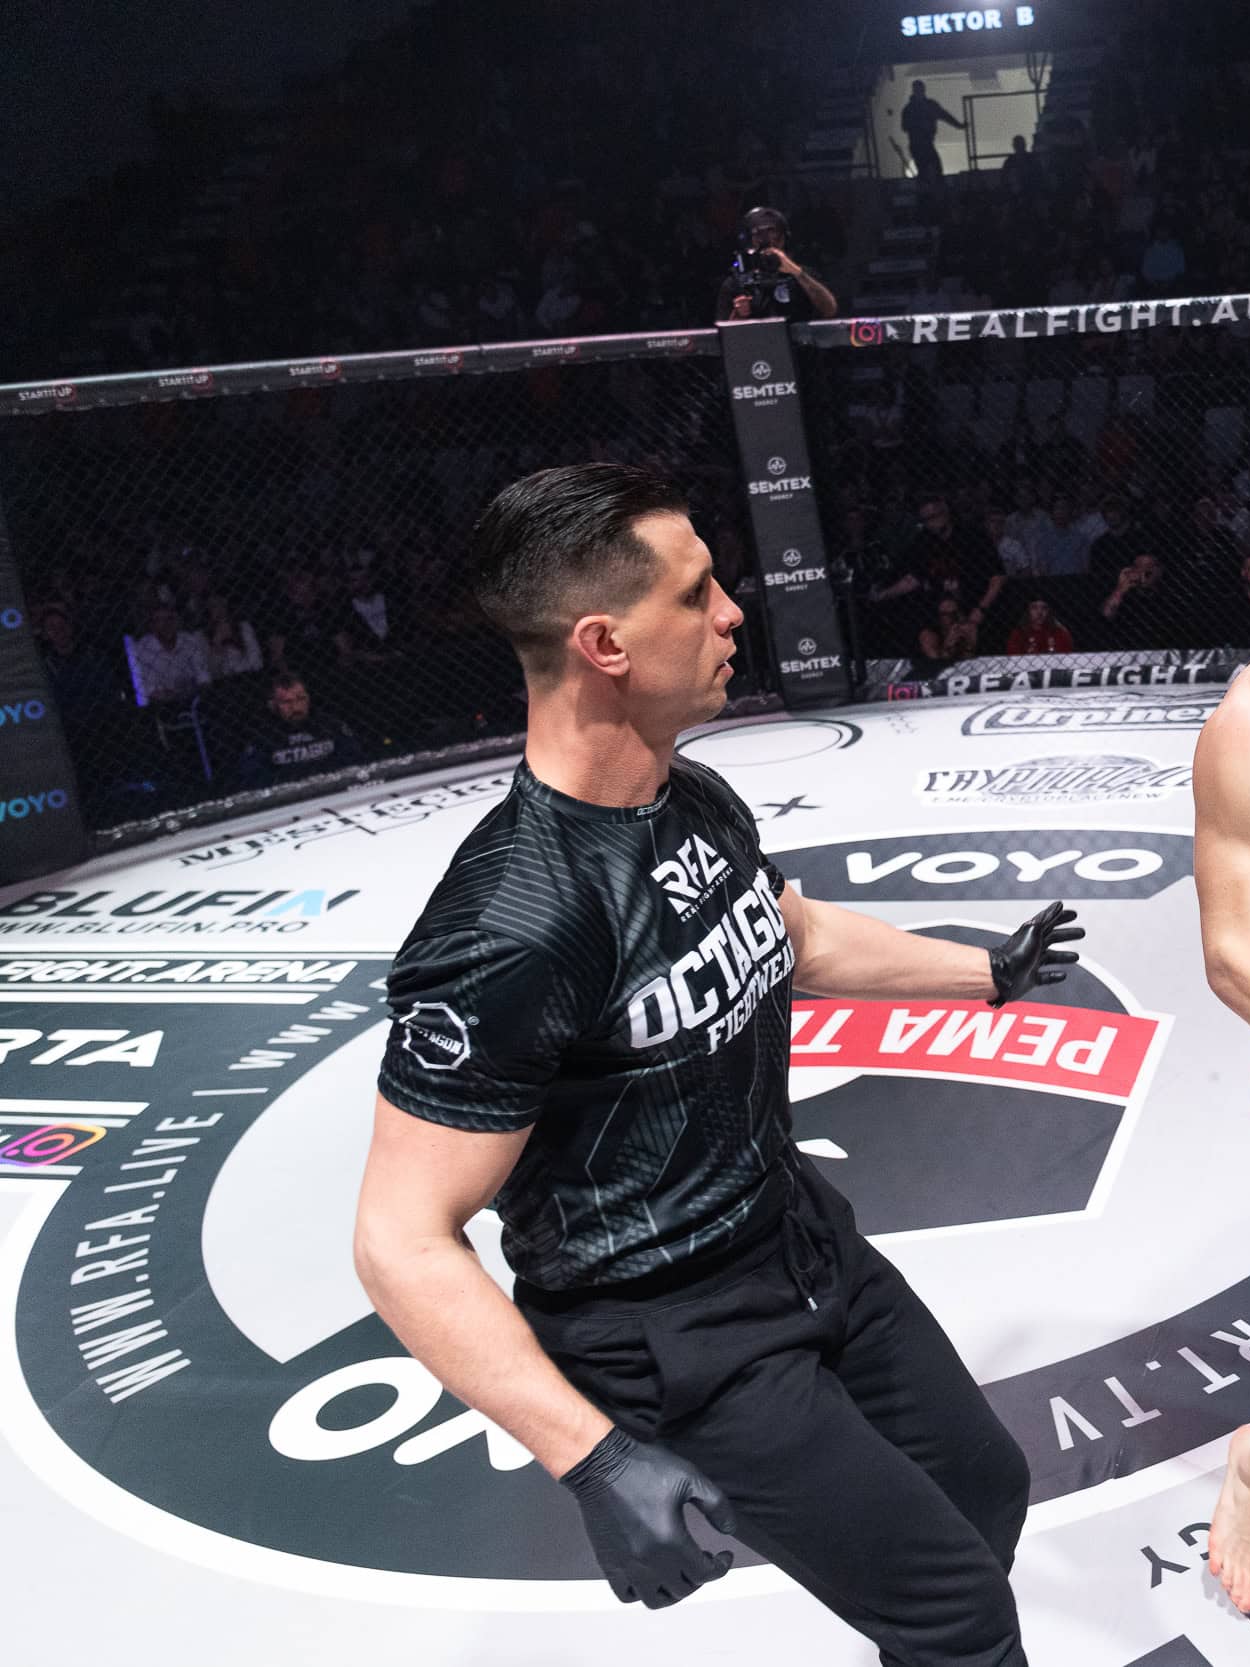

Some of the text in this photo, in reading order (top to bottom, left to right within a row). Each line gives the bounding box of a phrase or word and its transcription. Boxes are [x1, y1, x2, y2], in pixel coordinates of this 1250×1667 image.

[901, 6, 1034, 37] SEKTOR B
[732, 381, 797, 400] SEMTEX
[748, 475, 812, 495] SEMTEX
[764, 567, 827, 587] SEMTEX
[779, 655, 841, 674] SEMTEX
[0, 789, 67, 822] OYO
[846, 848, 1164, 884] VOYO
[0, 890, 361, 917] BLUFIN
[628, 867, 786, 1049] OCTAGO
[878, 1008, 1119, 1076] PEMA
